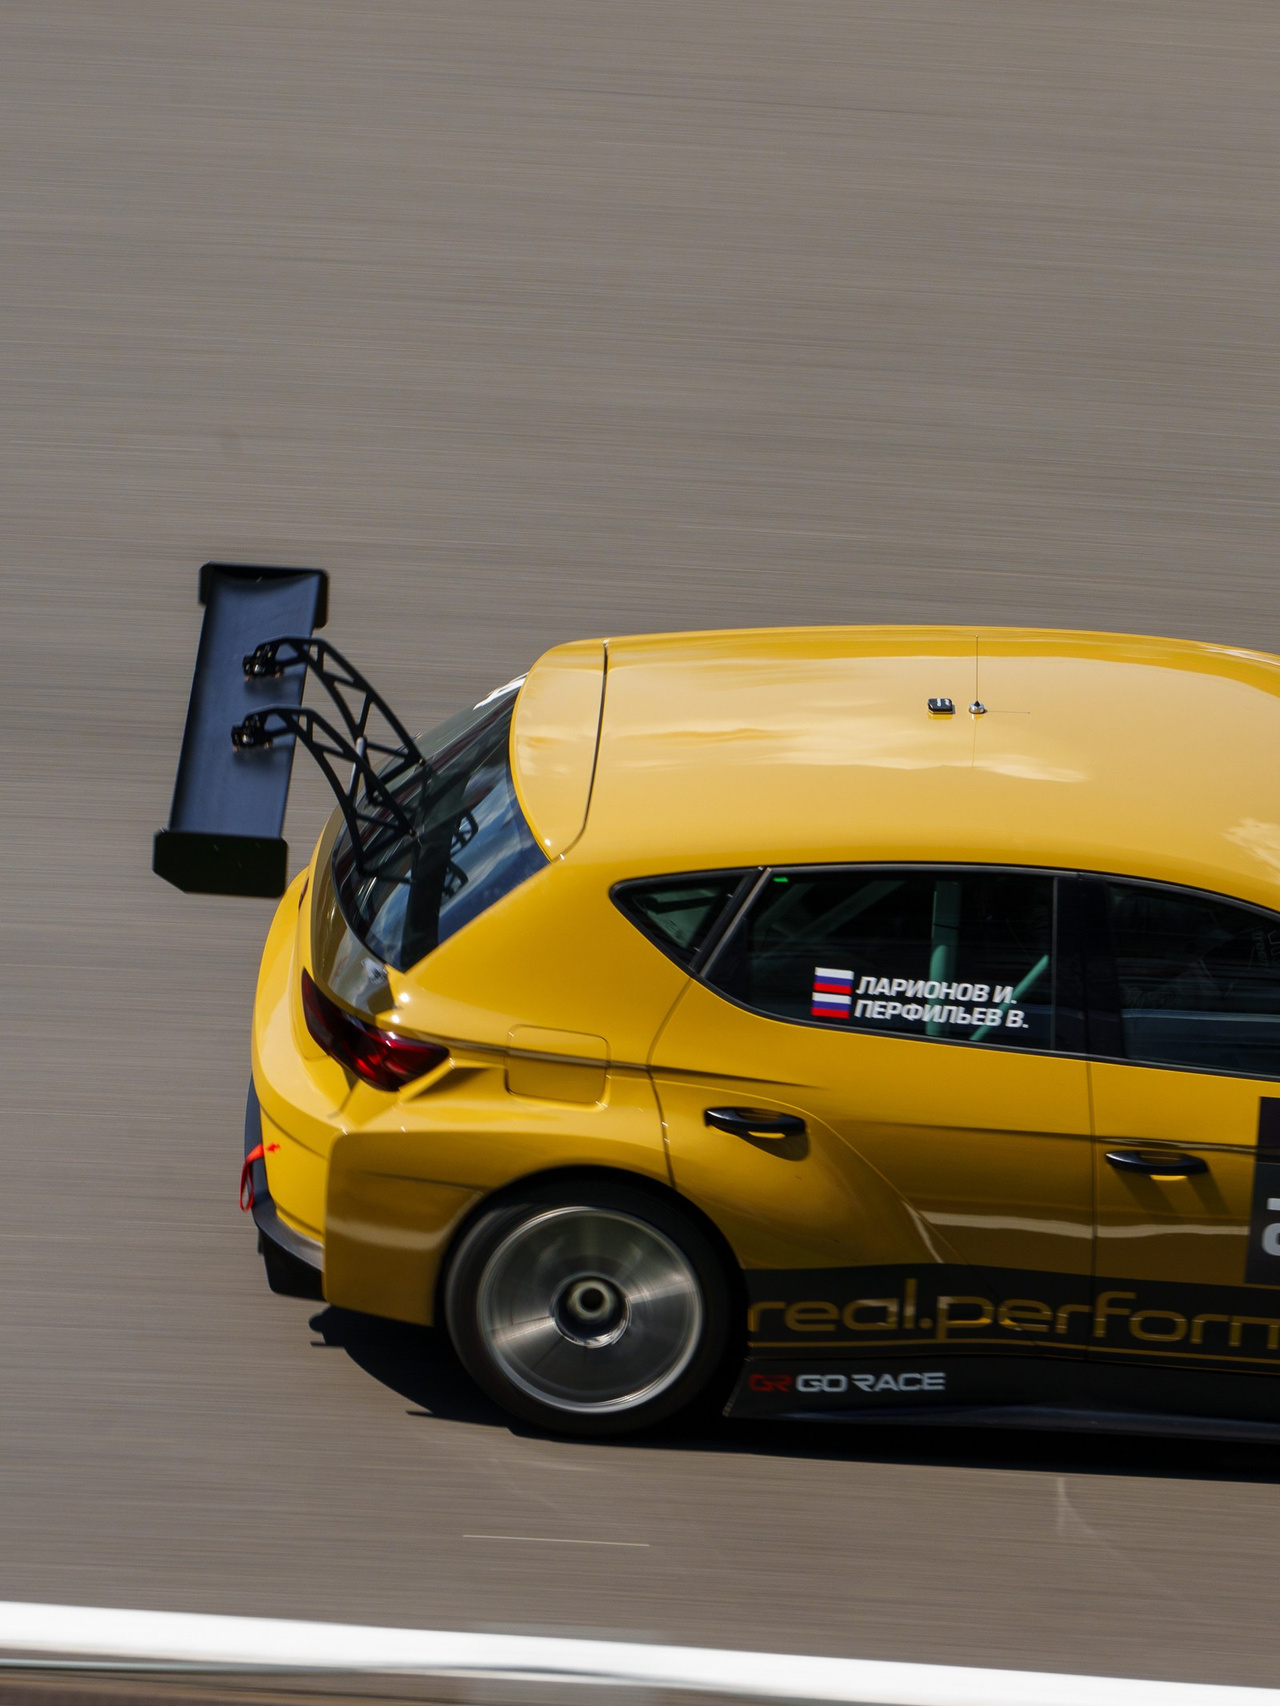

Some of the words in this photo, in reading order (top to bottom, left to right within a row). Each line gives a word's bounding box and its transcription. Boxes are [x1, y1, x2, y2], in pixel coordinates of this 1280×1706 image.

[856, 976, 989, 1003] ЛАРИОНОВ
[992, 985, 1018, 1005] И.
[854, 999, 1003, 1027] ПЕРФИЛЬЕВ
[1005, 1009, 1030, 1029] В.
[796, 1374, 848, 1393] GO
[850, 1372, 946, 1393] RACE
